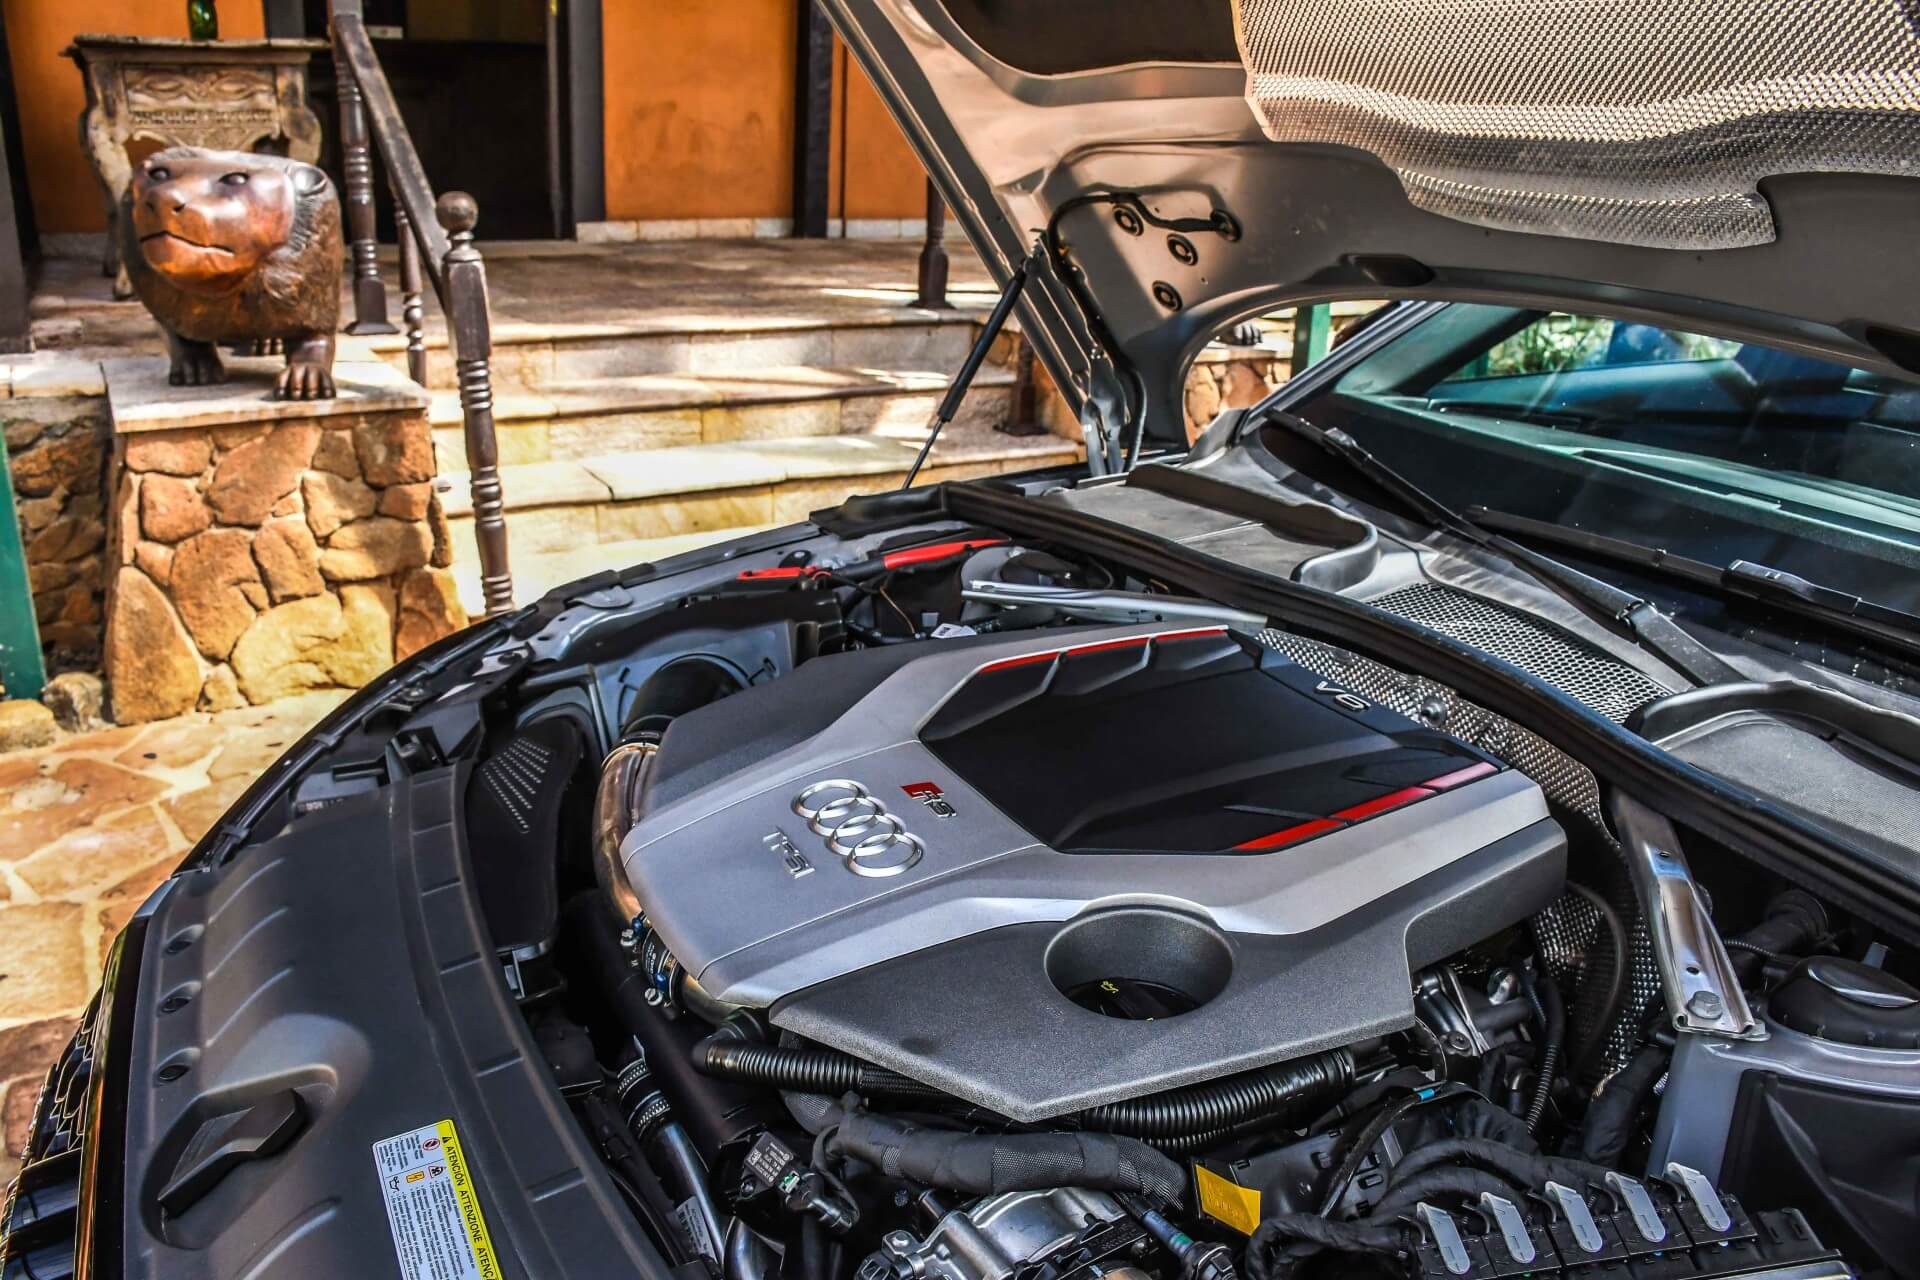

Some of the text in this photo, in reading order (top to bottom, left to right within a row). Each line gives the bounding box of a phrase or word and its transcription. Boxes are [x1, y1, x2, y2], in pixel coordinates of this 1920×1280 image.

[1315, 680, 1372, 709] V6
[903, 782, 957, 819] RS
[446, 1146, 465, 1186] ATENCIÓN
[459, 1190, 483, 1243] ATTENZIONE
[476, 1247, 495, 1280] ATENÇ
